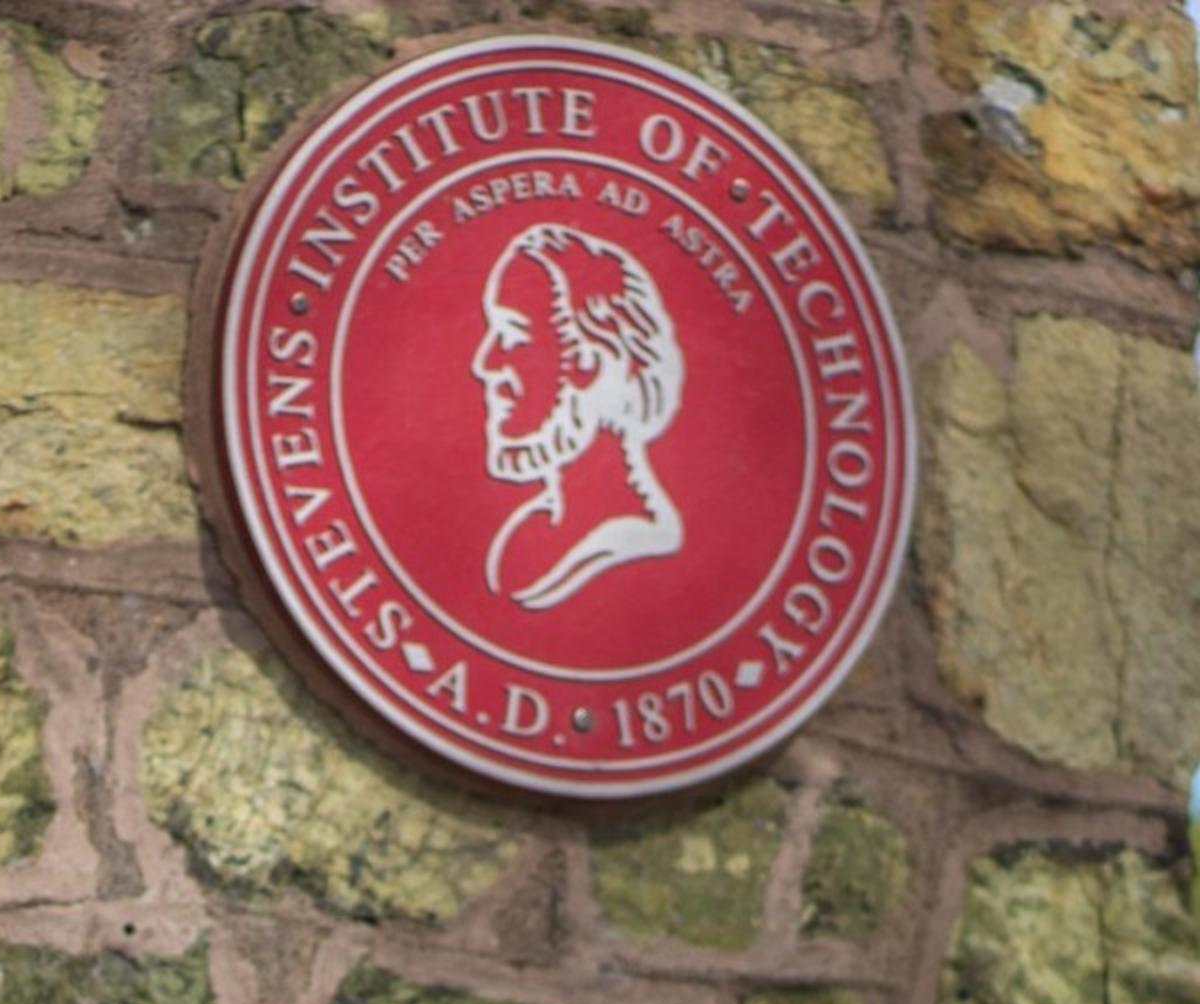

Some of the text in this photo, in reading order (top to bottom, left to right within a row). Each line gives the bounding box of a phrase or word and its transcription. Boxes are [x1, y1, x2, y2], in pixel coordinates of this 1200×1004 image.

[385, 170, 755, 314] PER ASPERA AD ASTRA
[268, 88, 874, 674] STEVENS INSTITUTE OF TECHNOLOGY
[612, 669, 734, 747] 1870
